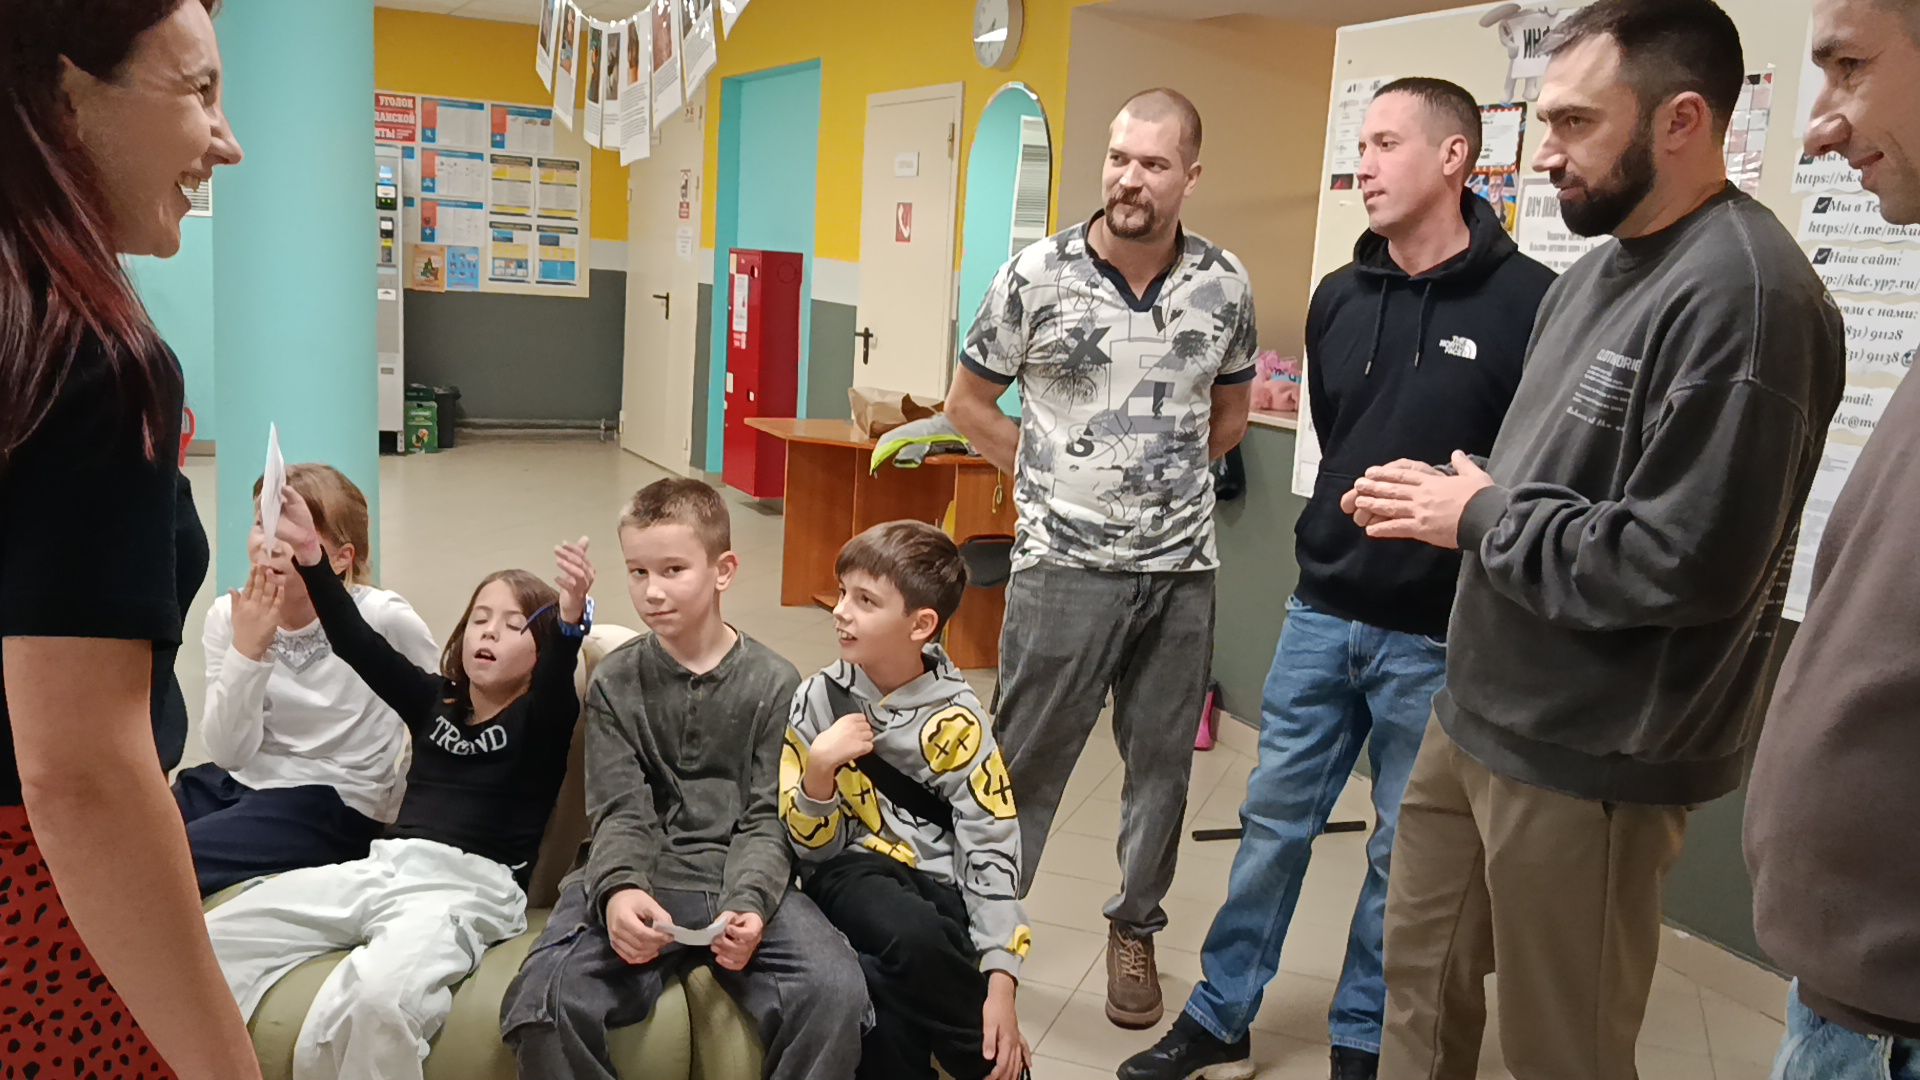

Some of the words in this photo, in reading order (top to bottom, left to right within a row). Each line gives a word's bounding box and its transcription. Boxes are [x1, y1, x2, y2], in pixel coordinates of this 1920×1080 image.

[379, 96, 414, 108] УГОЛОК
[1828, 200, 1852, 213] Мы
[1854, 203, 1861, 213] в
[1865, 200, 1881, 214] Те
[1828, 251, 1858, 264] Наш
[1861, 253, 1902, 266] сайт:
[1840, 305, 1864, 316] язи
[1867, 308, 1875, 317] с
[1877, 309, 1918, 320] нами:
[1870, 328, 1904, 341] 91128
[1866, 351, 1901, 365] 91138
